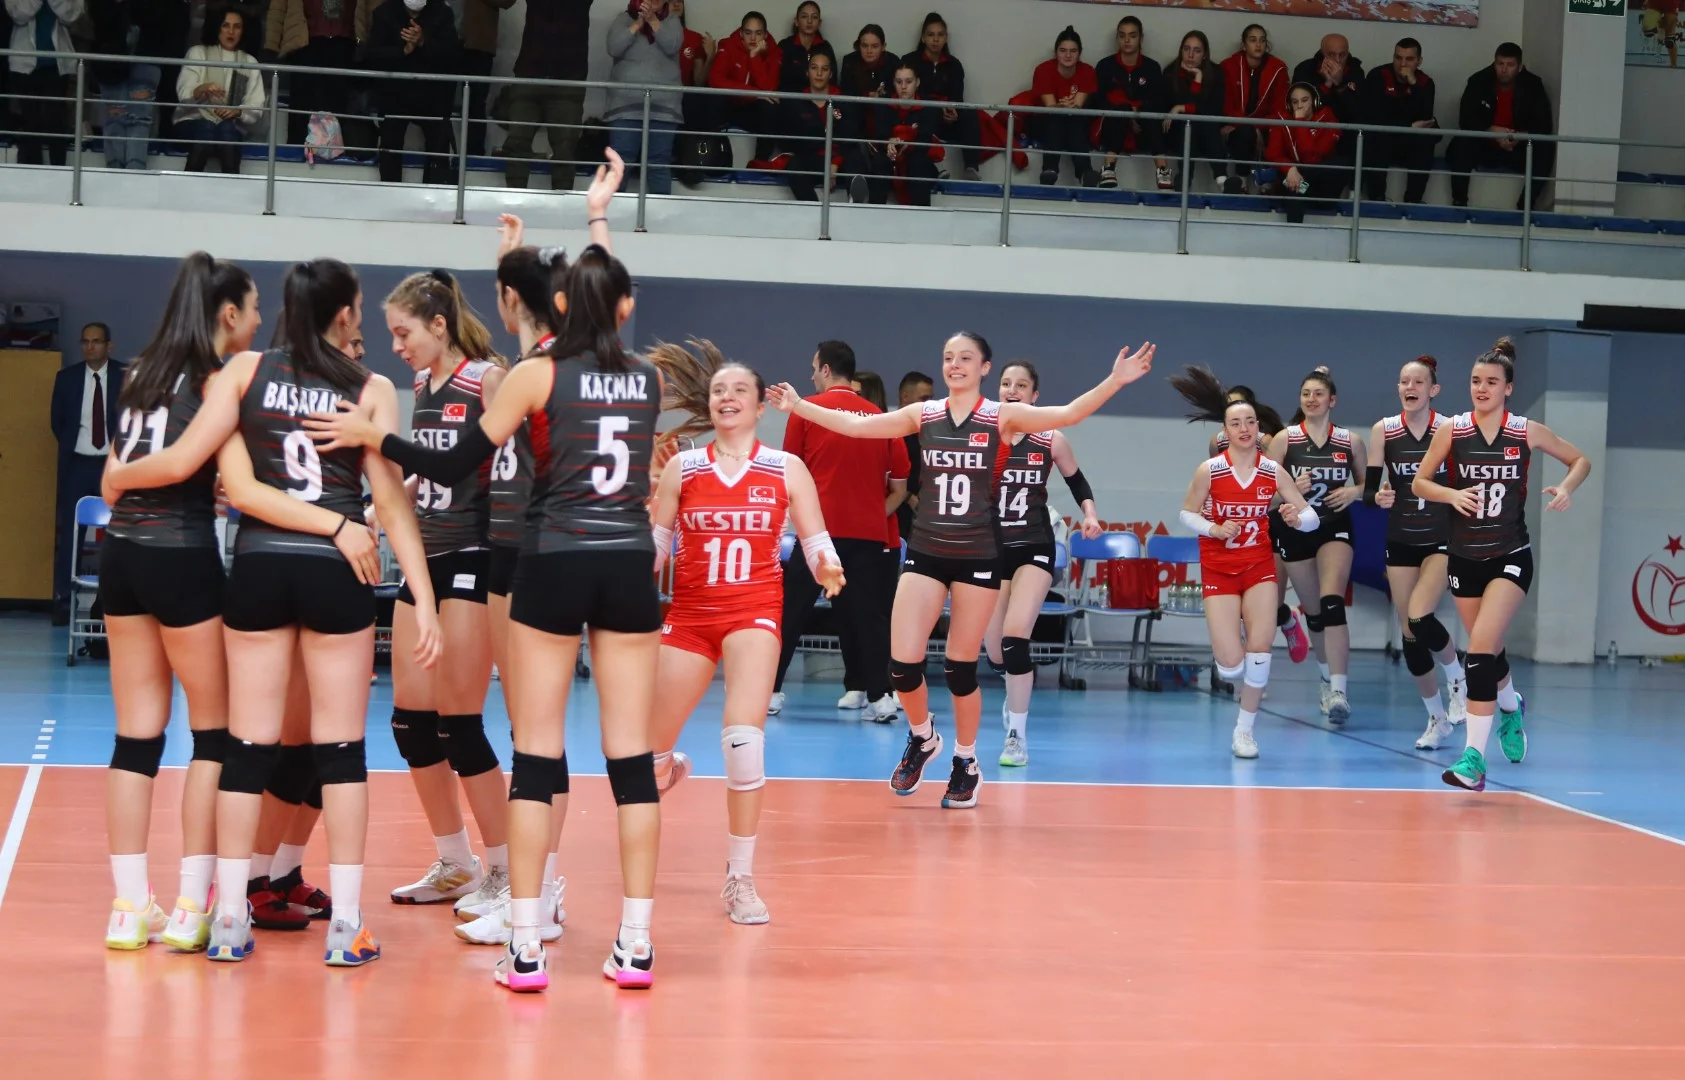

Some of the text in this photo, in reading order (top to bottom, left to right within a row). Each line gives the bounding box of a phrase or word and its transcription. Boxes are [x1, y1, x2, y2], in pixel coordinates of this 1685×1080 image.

[580, 374, 648, 404] KAÇMAZ
[120, 406, 169, 465] 21
[411, 428, 458, 451] ESTEL
[284, 430, 323, 501] 9
[592, 416, 630, 495] 5
[922, 449, 988, 470] VESTEL
[1000, 469, 1043, 485] STEL
[1291, 464, 1348, 481] VESTEL
[1391, 461, 1448, 476] VESL
[1458, 463, 1520, 480] VESTEL
[934, 472, 971, 516] 19
[999, 485, 1029, 519] 14
[1308, 482, 1328, 507] 2
[1473, 482, 1506, 519] 18
[683, 511, 773, 532] VESTEL
[1216, 502, 1268, 518] VESTEL
[1225, 520, 1260, 549] 22
[704, 537, 752, 585] 10
[1448, 574, 1460, 589] 18
